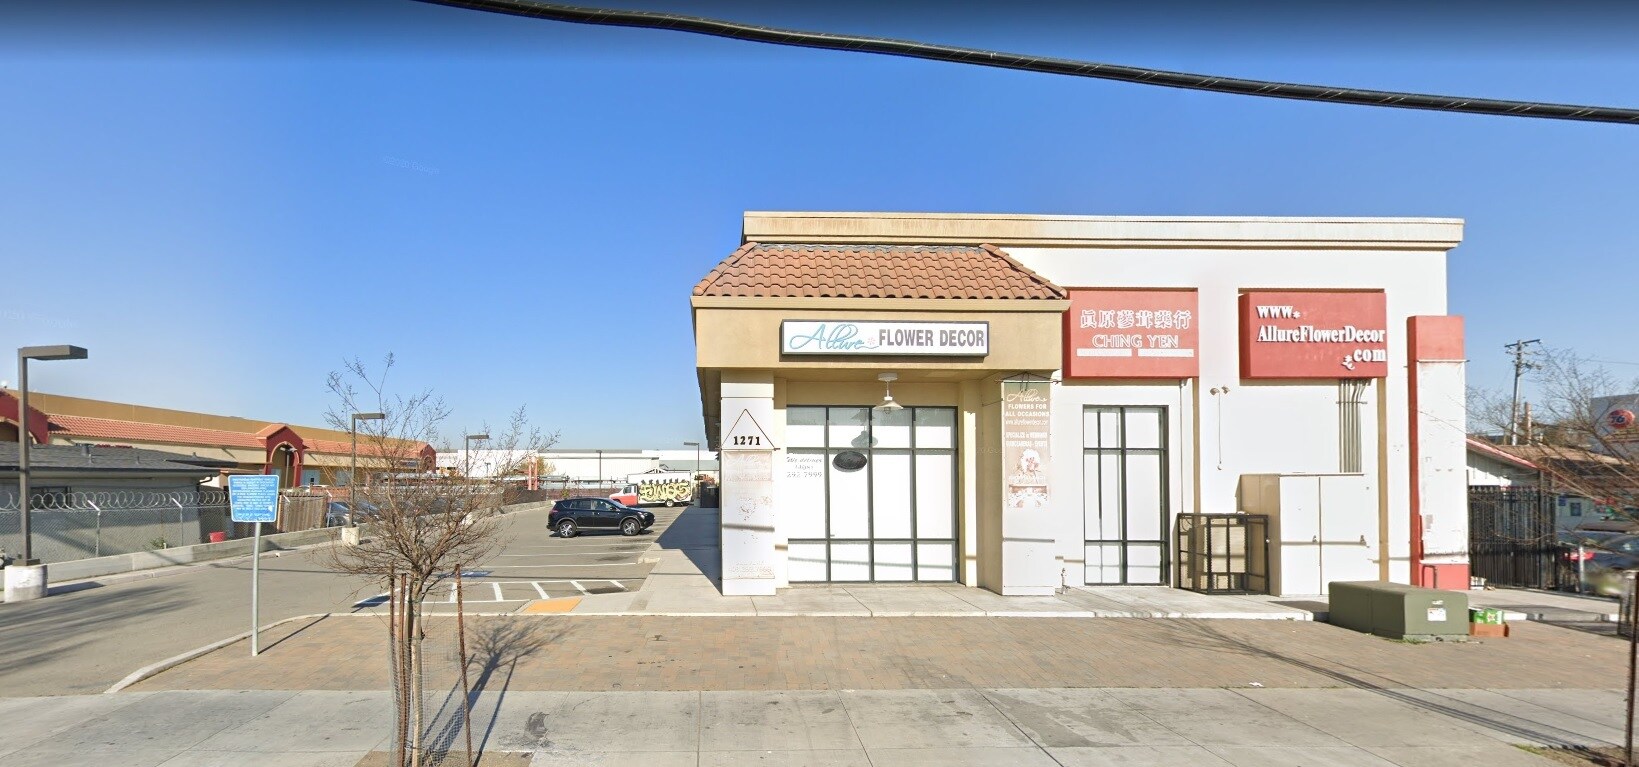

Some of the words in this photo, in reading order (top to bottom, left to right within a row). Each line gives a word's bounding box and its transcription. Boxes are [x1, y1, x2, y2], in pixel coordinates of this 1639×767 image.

[789, 324, 876, 350] Allure
[879, 329, 934, 347] FLOWER
[939, 330, 984, 347] DECOR
[1092, 334, 1142, 348] CHING
[1147, 335, 1179, 348] YEN
[1257, 325, 1386, 342] AllureFlowerDecor
[733, 435, 761, 446] 1271
